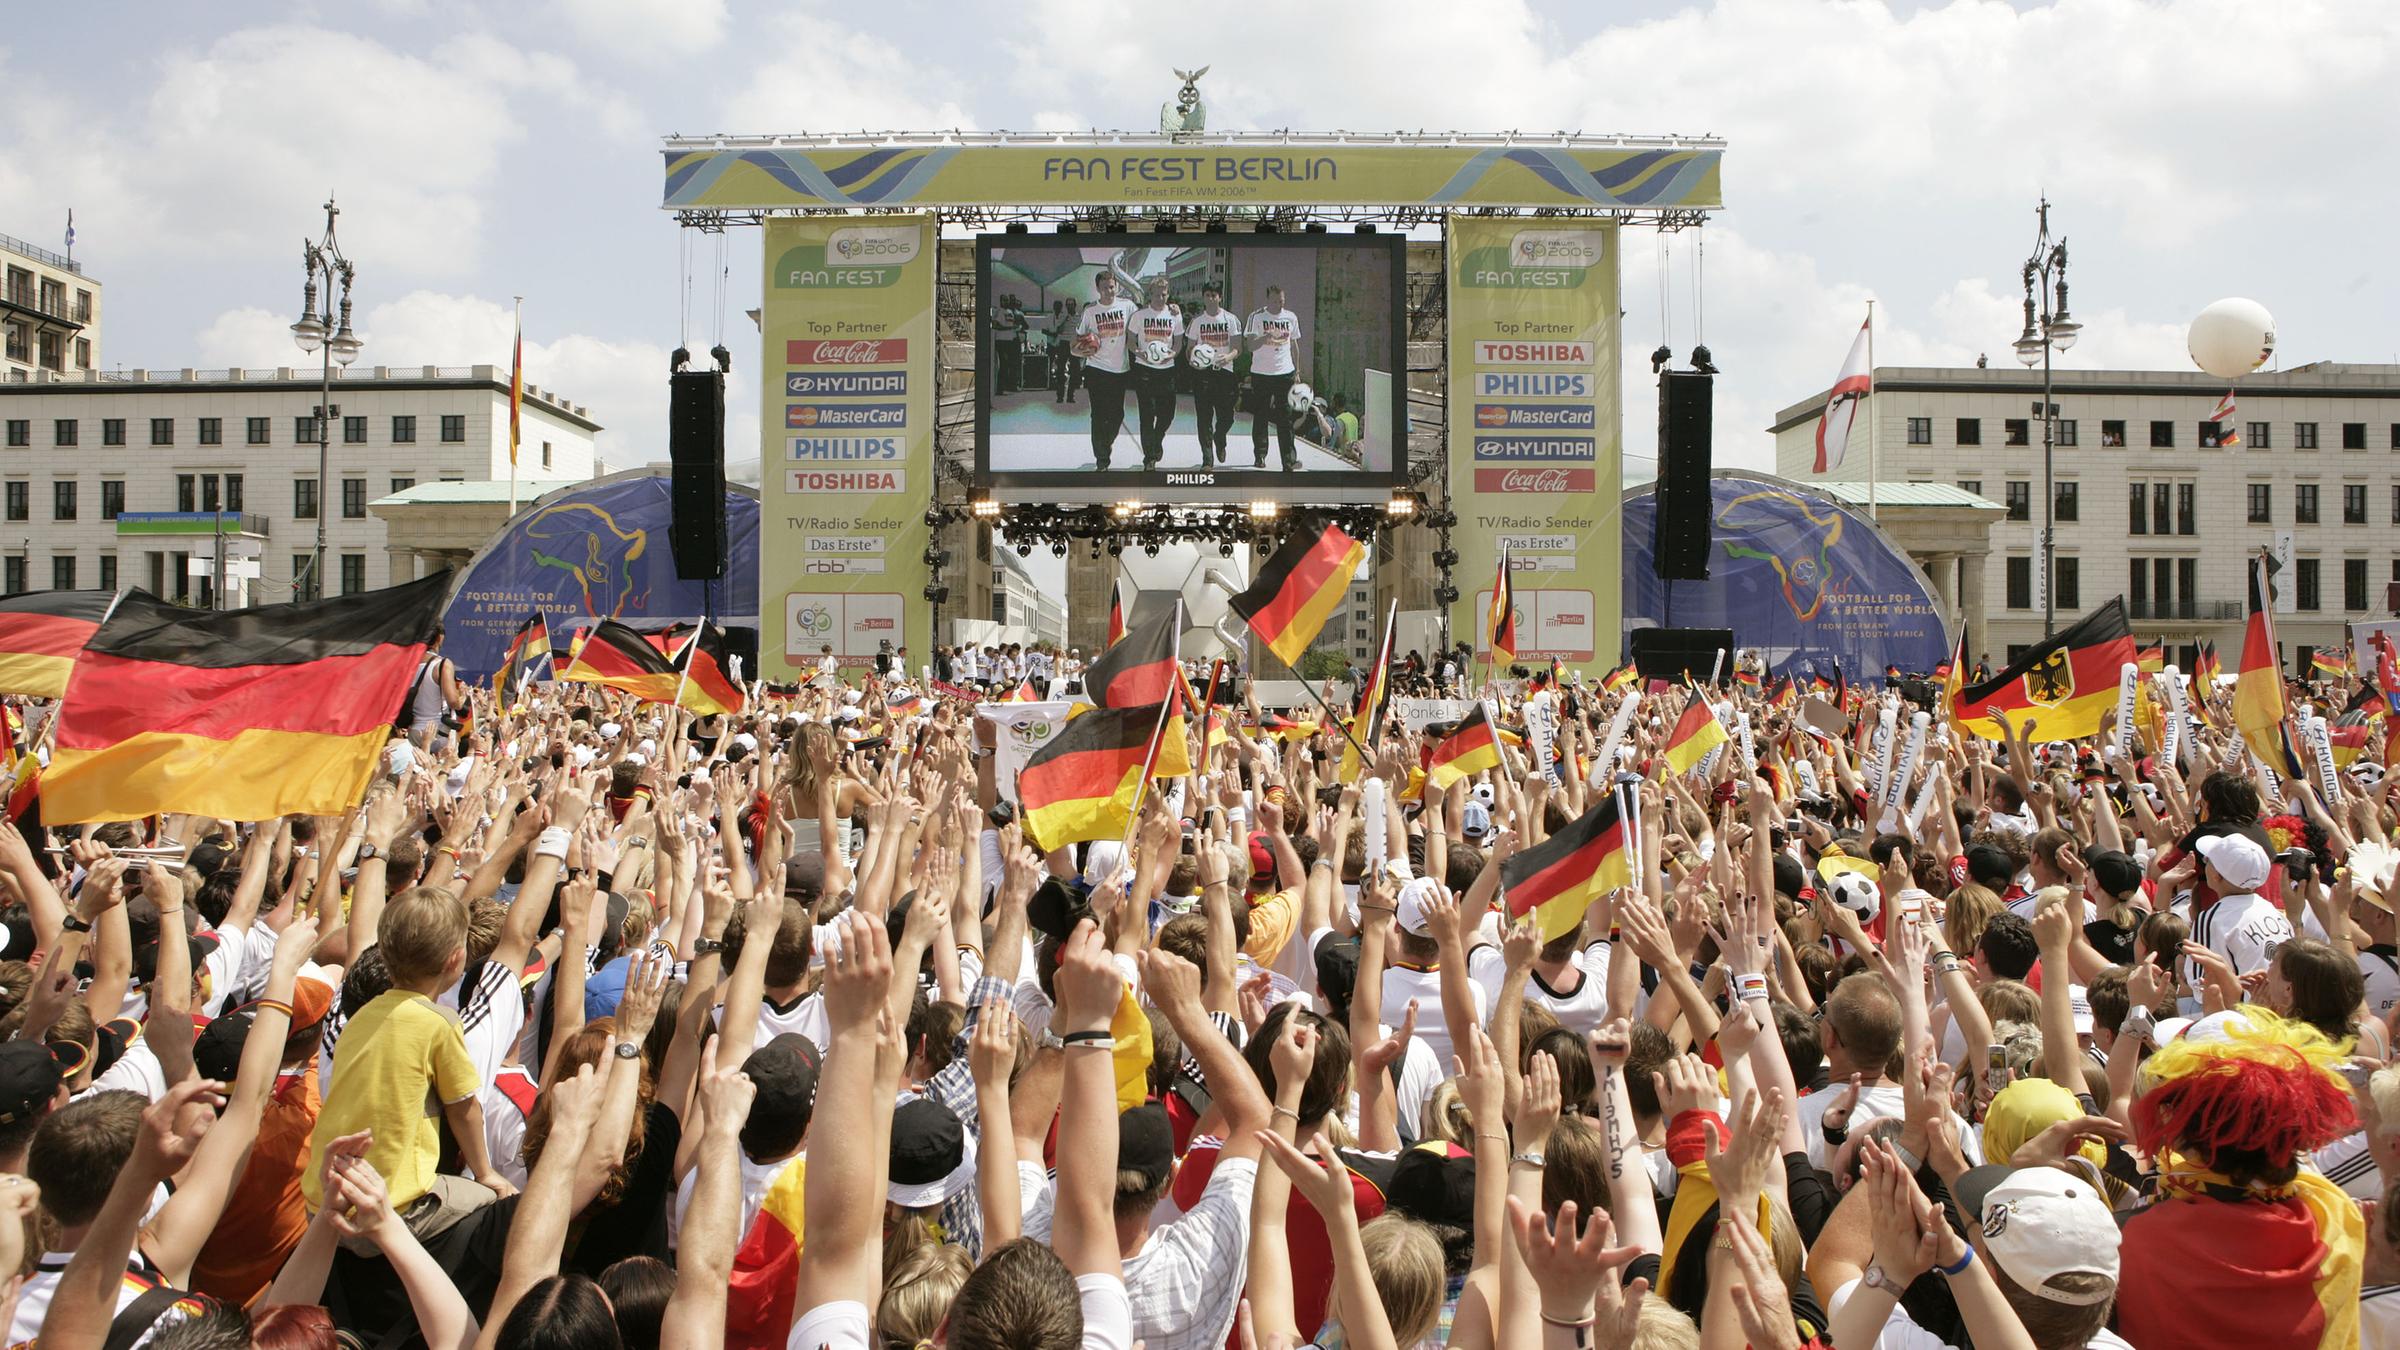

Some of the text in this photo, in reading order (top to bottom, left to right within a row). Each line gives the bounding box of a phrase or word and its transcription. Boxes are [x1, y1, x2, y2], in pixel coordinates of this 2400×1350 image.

[1044, 157, 1337, 181] FAN FEST BERLIN
[1124, 186, 1143, 197] Fan
[1146, 186, 1167, 197] Fest
[1170, 186, 1193, 197] FIFA
[1195, 186, 1217, 197] WM
[864, 243, 911, 255] 2006
[1547, 246, 1593, 256] 2006
[790, 270, 886, 285] FAN FEST
[1475, 271, 1570, 286] FAN FEST
[1095, 310, 1124, 324] DANKE
[1144, 318, 1173, 328] DANKE
[807, 321, 888, 336] Top Partner
[1200, 322, 1229, 333] DANKE
[1262, 320, 1290, 331] DANKE
[1494, 321, 1575, 336] Top Partner
[1484, 345, 1585, 361] TOSHIBA
[817, 376, 905, 391] HYUNDAI
[1484, 374, 1585, 395] PHILIPS
[819, 408, 903, 424] MasterCard
[1509, 409, 1593, 424] MasterCard
[795, 439, 896, 459] PHILIPS
[1506, 442, 1593, 456] HYUNDAI
[794, 473, 896, 489] TOSHIBA
[1166, 474, 1215, 485] PHILIPS
[787, 517, 903, 530] TV/Radio Sender
[1477, 516, 1593, 529] TV/Radio Sender
[811, 539, 872, 551] Das Erste
[1502, 537, 1563, 549] Das Erste
[806, 560, 845, 573] rbb
[466, 591, 554, 601] FOOTBALL FOR
[1822, 593, 1912, 603] FOOTBALL FOR
[474, 603, 577, 614] A BETTER WORLD
[1831, 605, 1935, 615] A BETTER WORLD
[461, 619, 484, 627] FROM
[869, 619, 893, 628] Berlin
[1562, 615, 1584, 624] Berlin
[1860, 630, 1889, 638] SOUTH
[1893, 630, 1925, 638] AFRICA
[1401, 703, 1449, 720] Danke!
[2164, 715, 2176, 761] HYUNDAI
[1887, 744, 1913, 807] HYUNDAI
